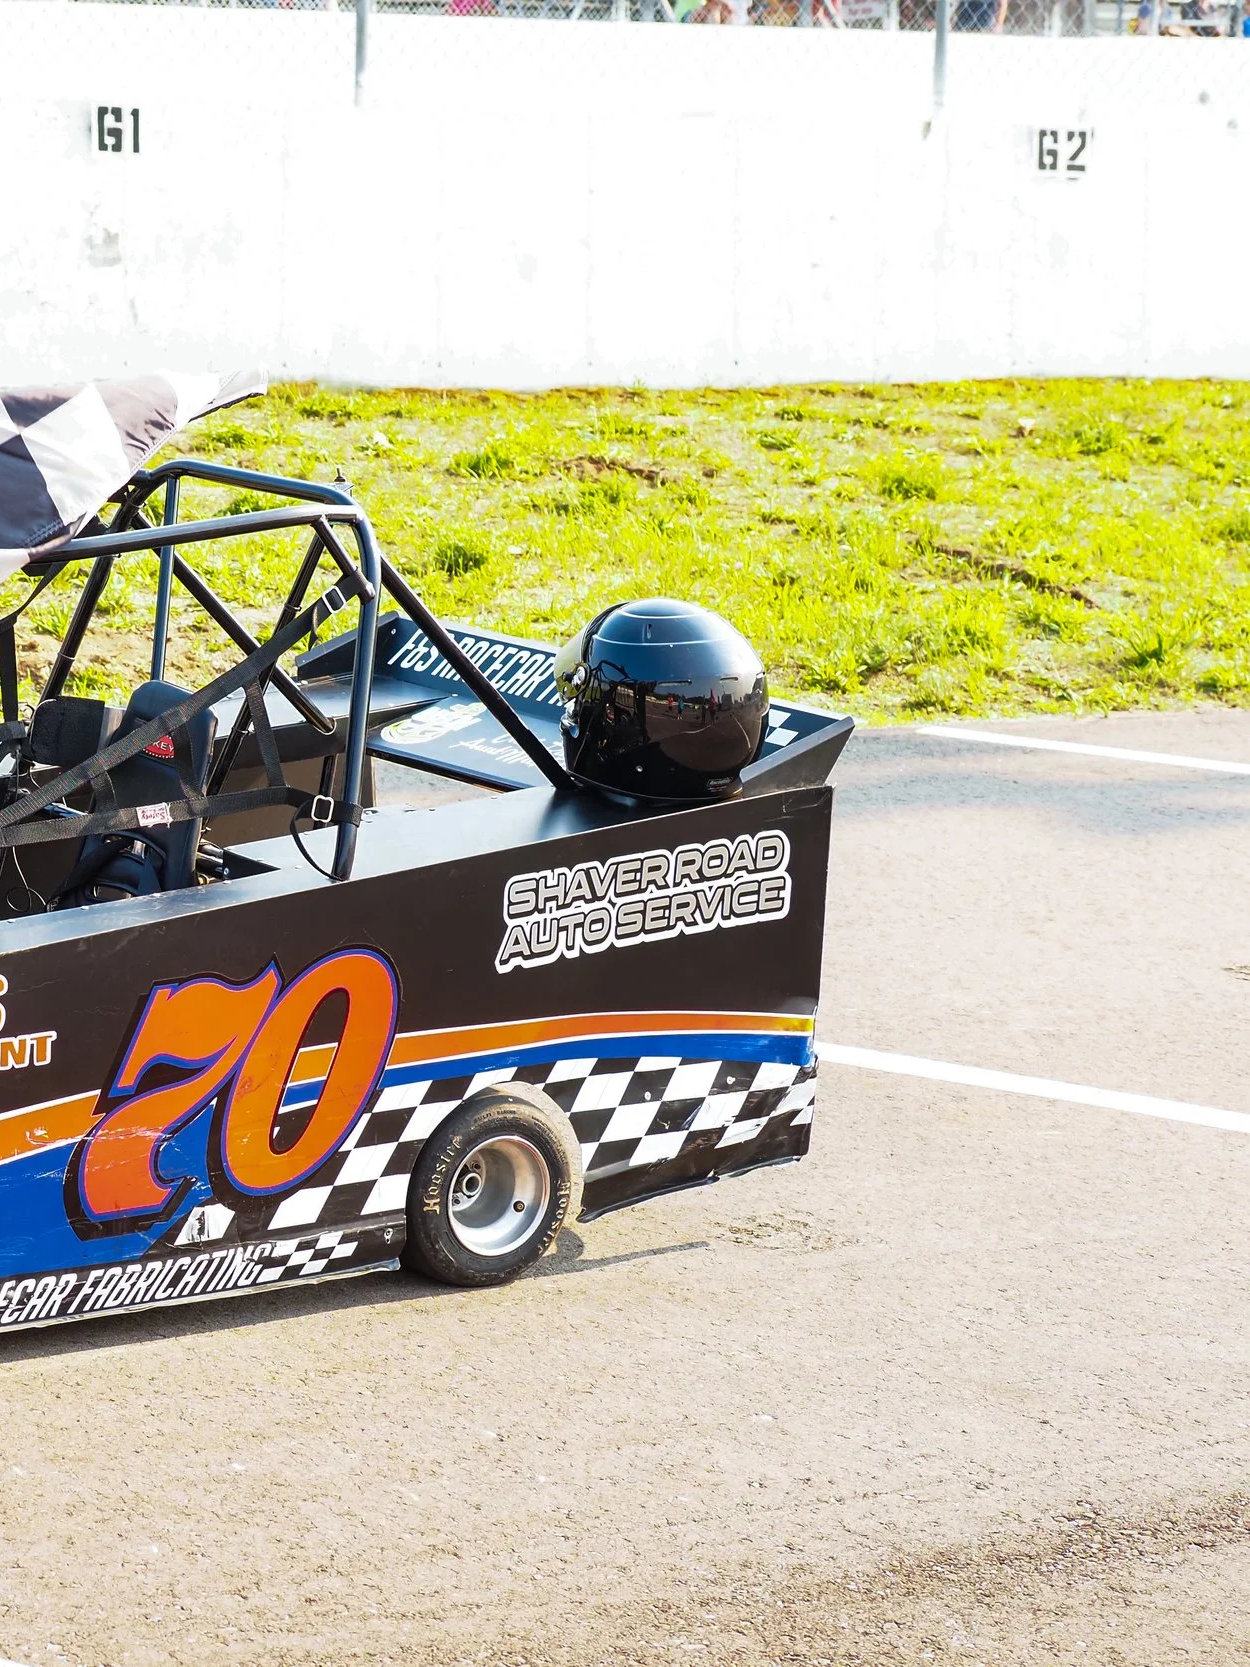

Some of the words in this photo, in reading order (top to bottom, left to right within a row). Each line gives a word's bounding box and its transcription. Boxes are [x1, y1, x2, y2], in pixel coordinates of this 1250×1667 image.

[152, 740, 175, 753] KEY
[507, 852, 670, 916] SHAVER
[673, 834, 786, 886] ROAD
[499, 904, 612, 964] AUTO
[614, 875, 786, 938] SERVICE
[72, 946, 400, 1230] 70
[70, 1242, 274, 1313] FABRICATING
